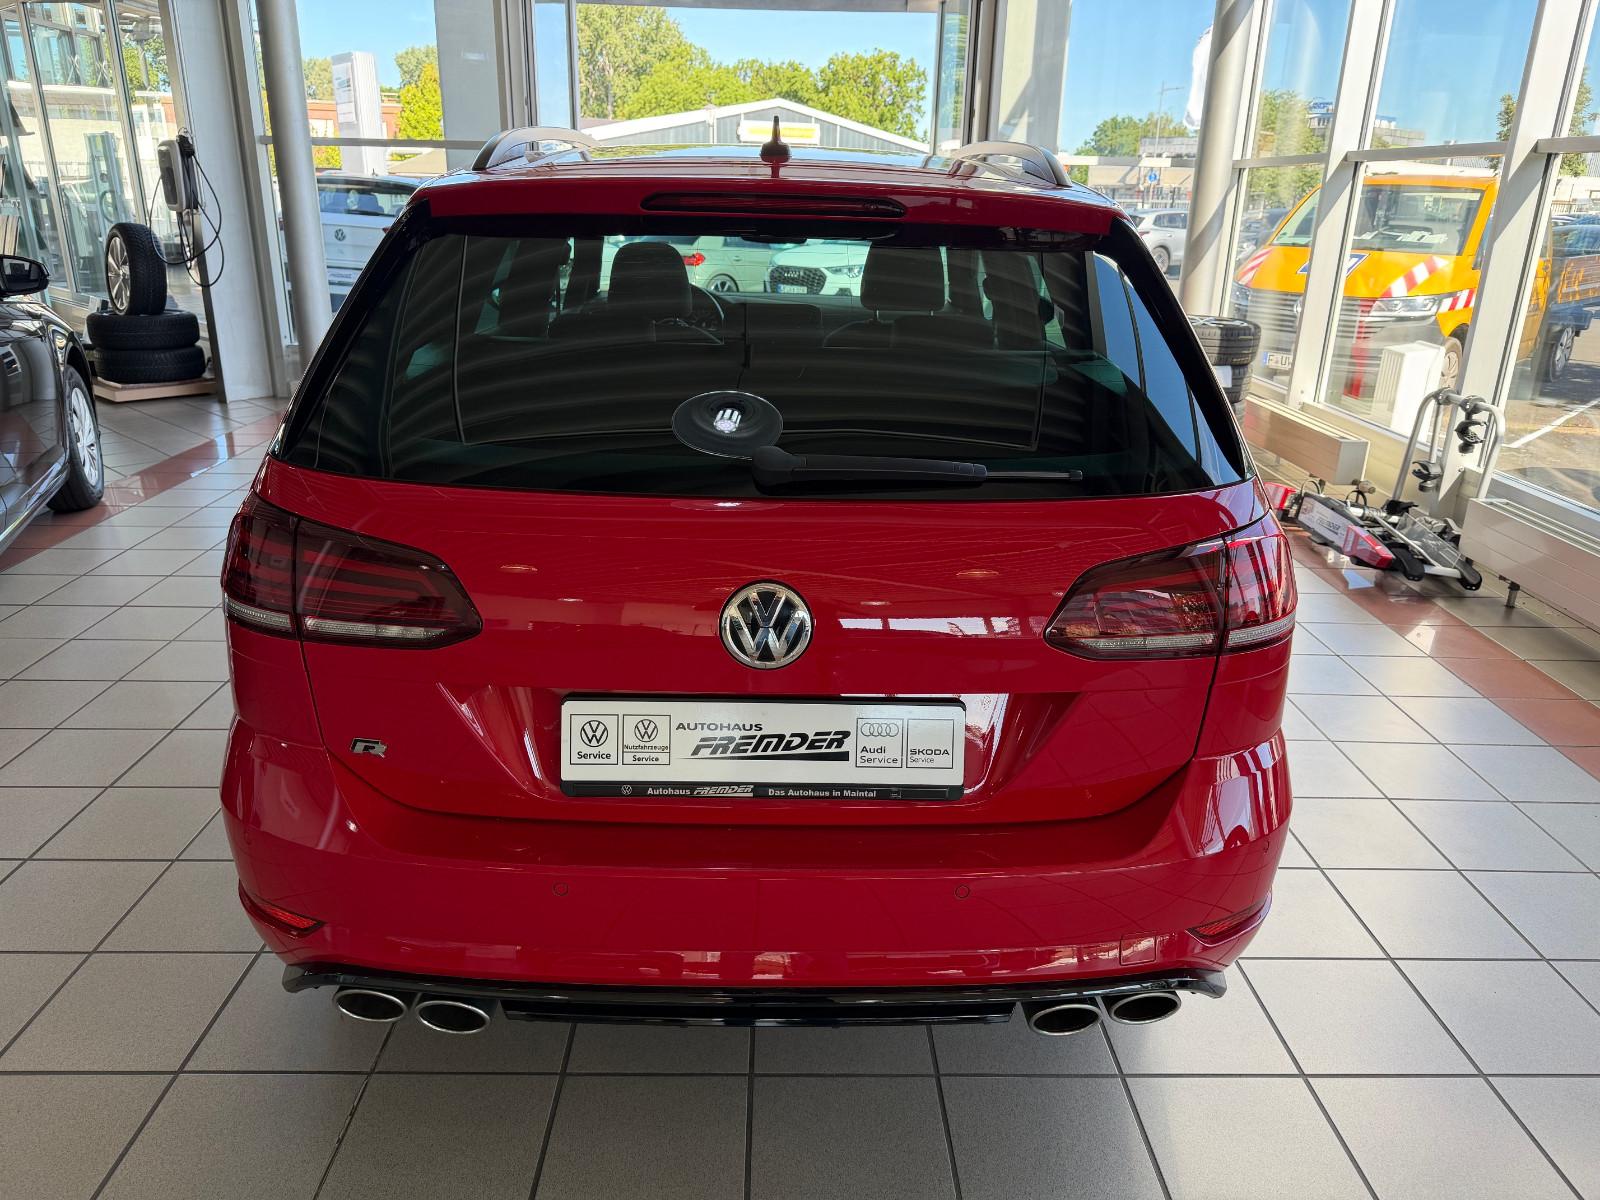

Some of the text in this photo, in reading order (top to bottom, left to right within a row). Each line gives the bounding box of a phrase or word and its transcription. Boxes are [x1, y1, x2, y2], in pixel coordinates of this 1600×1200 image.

[675, 722, 763, 732] AUTOHAUS
[350, 737, 387, 758] R
[624, 743, 669, 752] Nutzfahrzeuge
[690, 730, 851, 757] FREMDER
[860, 745, 886, 755] Audi
[577, 751, 612, 760] Service
[632, 754, 660, 763] Service
[860, 755, 899, 764] Service
[909, 756, 935, 764] Service
[647, 785, 754, 795] Autohaus FREMDER
[768, 788, 877, 797] Das Autohaus in Maintal
